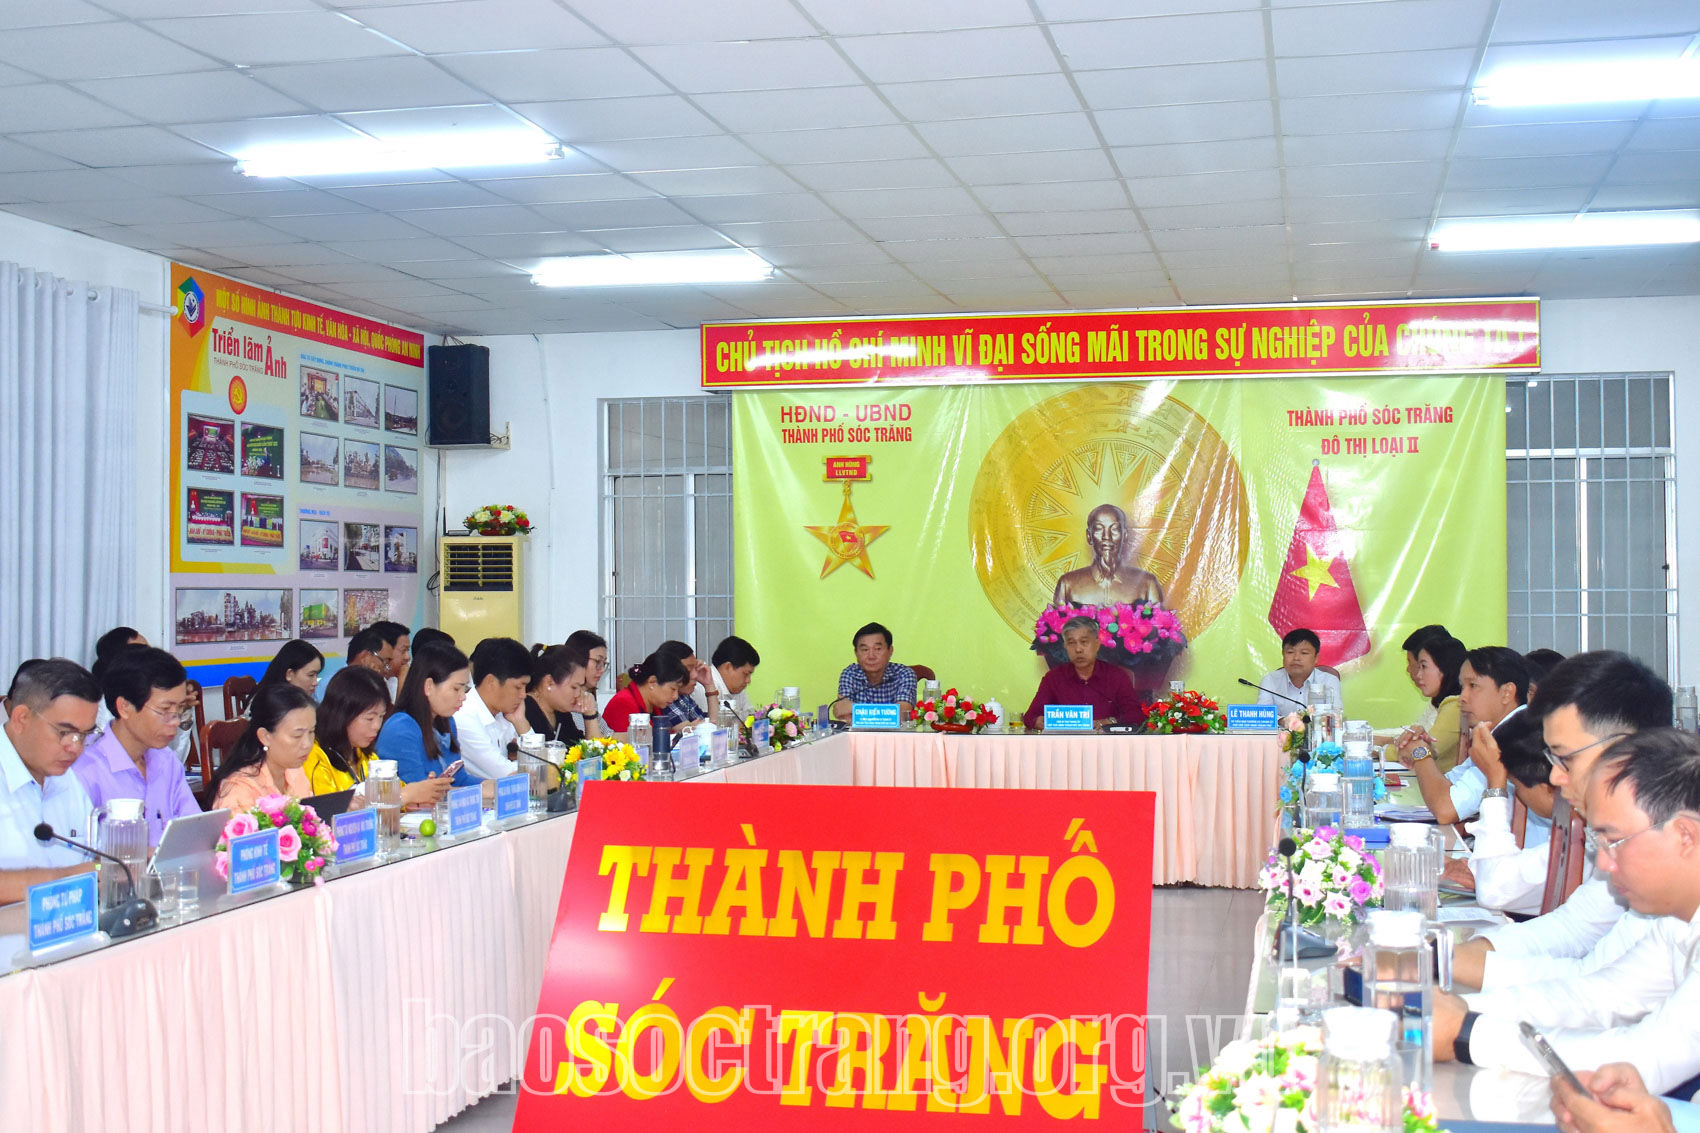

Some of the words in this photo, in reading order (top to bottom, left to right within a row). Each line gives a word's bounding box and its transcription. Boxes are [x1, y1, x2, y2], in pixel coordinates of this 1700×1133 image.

[212, 327, 240, 357] Triển
[243, 336, 263, 362] lãm
[264, 335, 287, 379] Ảnh
[716, 330, 757, 372] CHỦ
[762, 339, 807, 377] TỊCH
[815, 328, 842, 370] HỒ
[850, 330, 884, 369] CHÍ
[890, 336, 945, 368] MINH
[953, 329, 973, 366] VĨ
[979, 332, 1014, 372] ĐẠI
[1021, 322, 1079, 365] SỐNG
[1087, 324, 1128, 363] MÃI
[1136, 328, 1208, 362] TRONG
[1215, 322, 1245, 367] SỰ
[1252, 319, 1336, 365] NGHIỆP
[1344, 312, 1389, 358] CỦA
[781, 405, 836, 423] HĐND
[855, 403, 912, 422] UBND
[1287, 406, 1334, 426] THÀNH
[1338, 402, 1367, 425] PHỐ
[1372, 404, 1401, 425] SÓC
[1405, 402, 1453, 424] TRĂNG
[782, 425, 818, 443] THÀNH
[821, 422, 844, 443] PHỐ
[848, 424, 871, 442] SÓC
[874, 424, 912, 442] TRĂNG
[1321, 434, 1340, 455] ĐÔ
[1345, 438, 1367, 458] THỊ
[1372, 437, 1403, 457] LOẠI
[1230, 708, 1238, 718] LÊ
[1239, 710, 1258, 718] THANH
[598, 823, 904, 940] THÀNH
[922, 818, 1115, 948] PHỐ
[554, 977, 756, 1104] SÓC
[777, 991, 1108, 1120] TRĂNG
